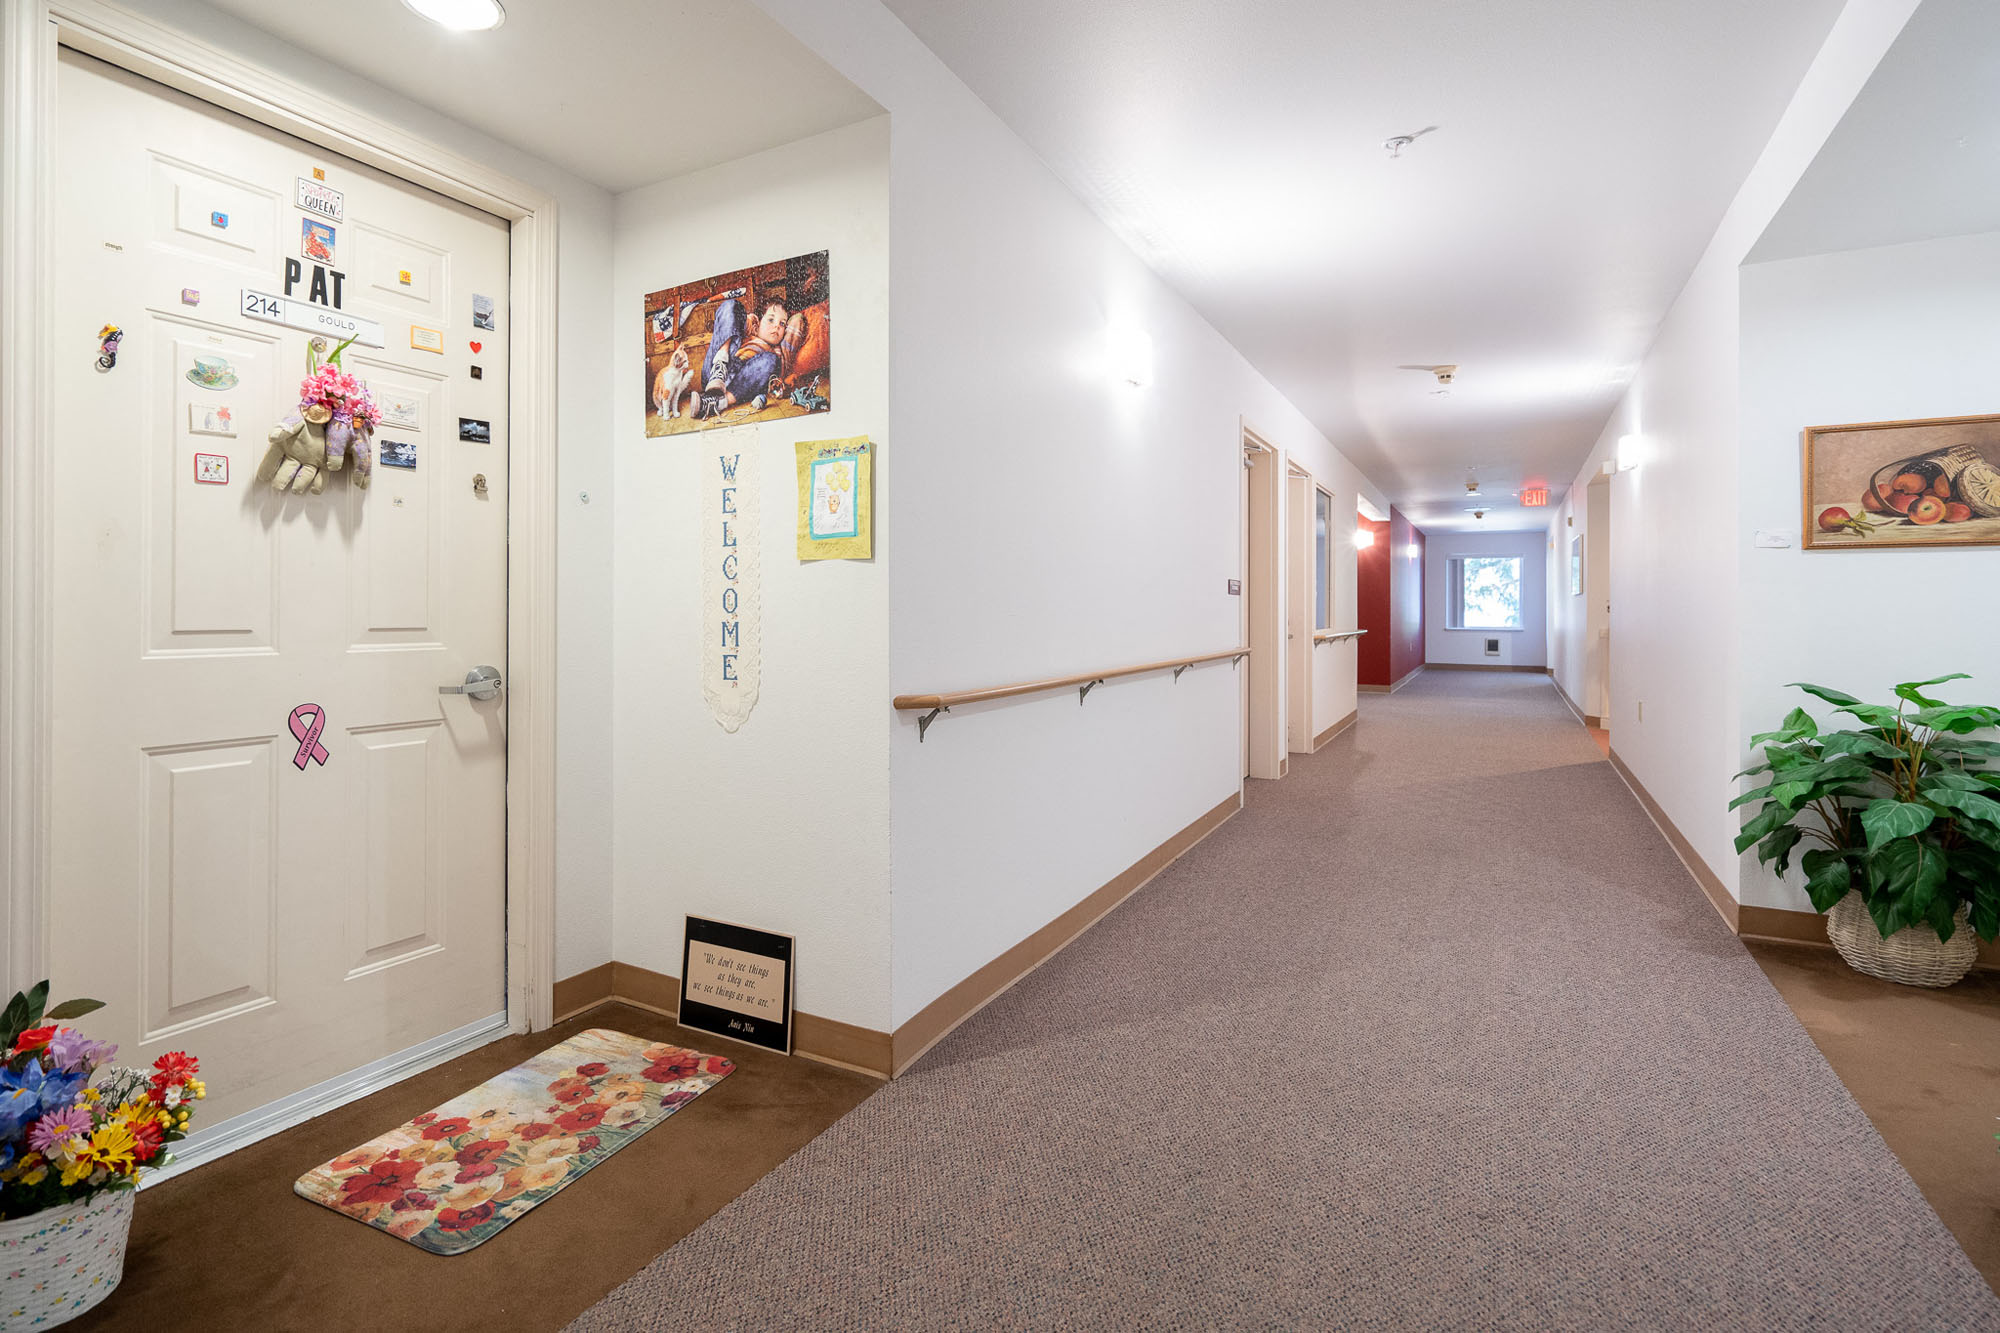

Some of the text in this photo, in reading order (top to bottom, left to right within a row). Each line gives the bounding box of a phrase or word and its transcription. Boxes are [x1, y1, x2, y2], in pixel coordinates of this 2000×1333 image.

[304, 194, 337, 216] QUEEN
[284, 256, 346, 310] PAT
[246, 294, 281, 317] 214
[318, 314, 356, 331] GOULD
[1524, 490, 1548, 506] EXIT
[719, 454, 741, 681] WELCOME
[300, 726, 319, 758] Survivor
[718, 956, 734, 969] don't
[736, 963, 746, 972] see
[748, 964, 769, 979] things
[717, 973, 726, 981] as
[727, 973, 742, 988] they
[692, 982, 702, 991] we
[704, 984, 714, 993] see
[715, 985, 736, 1001] things
[735, 993, 744, 1001] as
[746, 995, 755, 1004] we
